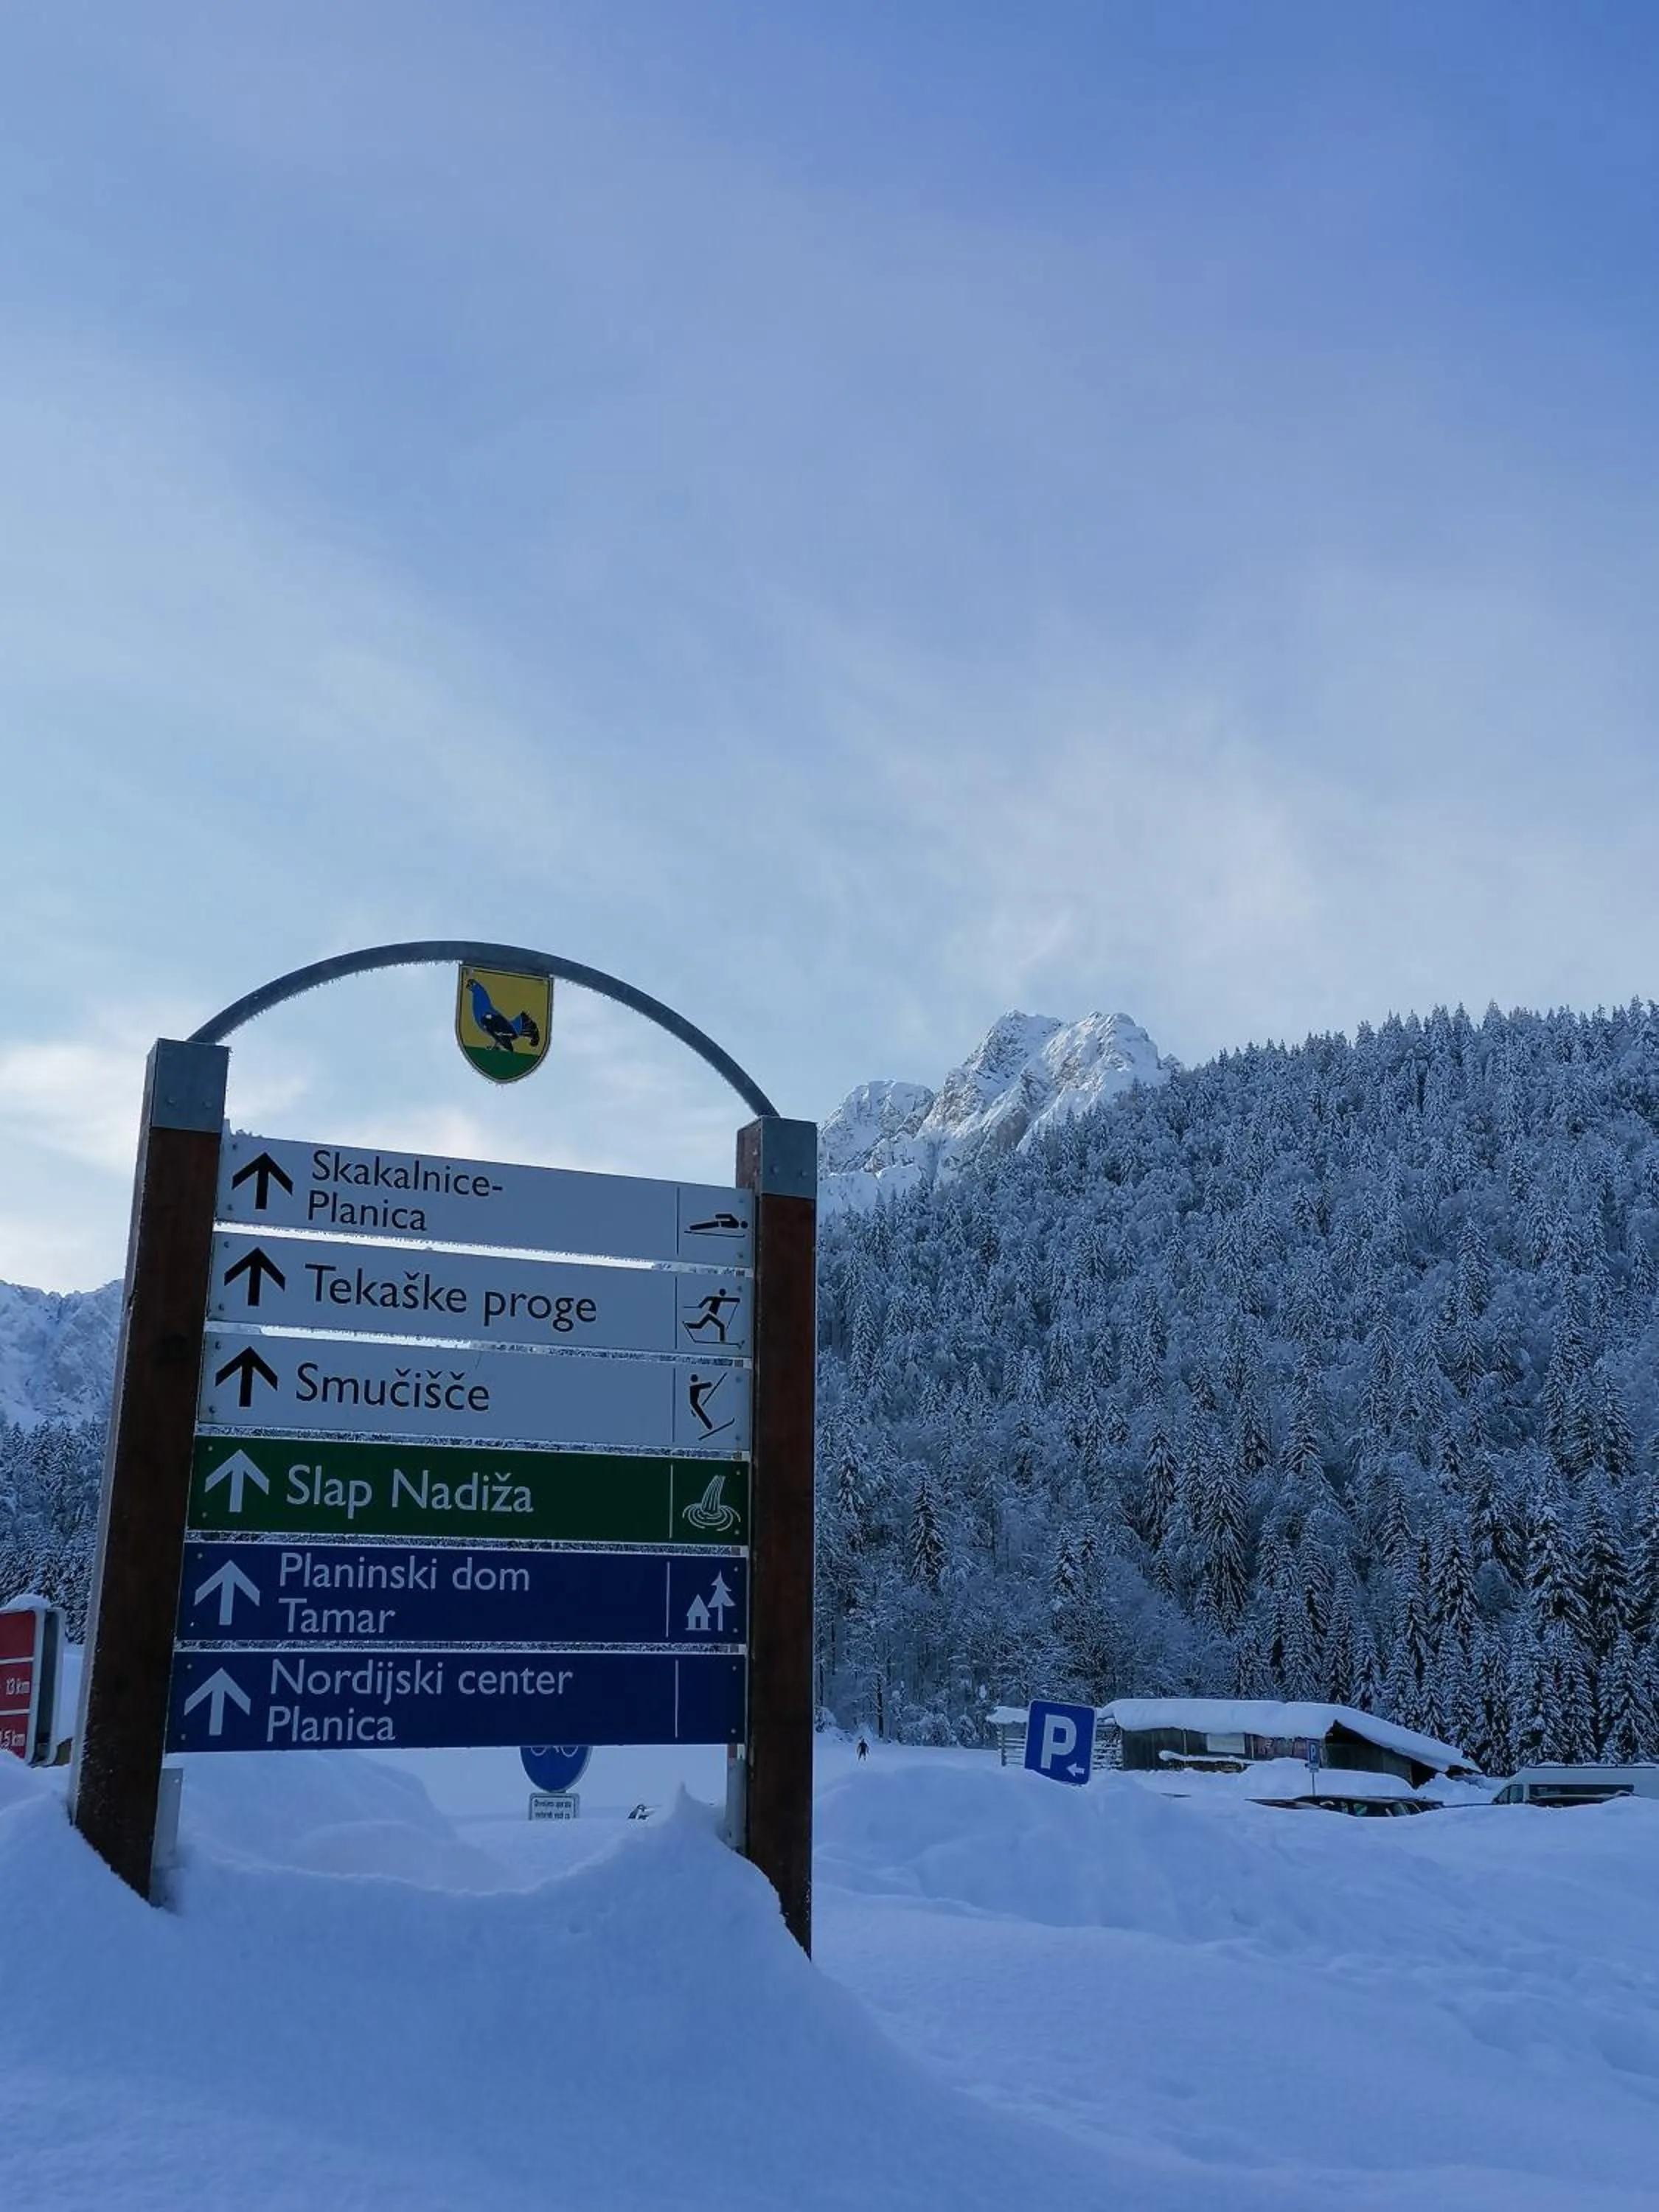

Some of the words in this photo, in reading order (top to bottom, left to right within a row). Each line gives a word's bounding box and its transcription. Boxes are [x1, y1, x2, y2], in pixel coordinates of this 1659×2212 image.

[312, 1149, 504, 1198] Skakalnice-
[307, 1189, 428, 1232] Planica
[305, 1263, 467, 1314] Tekaške
[483, 1290, 597, 1333] proge
[296, 1362, 490, 1412] Smučišče
[286, 1464, 373, 1520] Slap
[392, 1468, 535, 1514] Nadiža
[279, 1552, 438, 1590] Planinski
[452, 1557, 531, 1591] dom
[278, 1598, 397, 1634] Tamar
[271, 1658, 444, 1705] Nordijski
[458, 1667, 574, 1696] center
[266, 1705, 397, 1743] Planica
[1040, 1714, 1077, 1770] P
